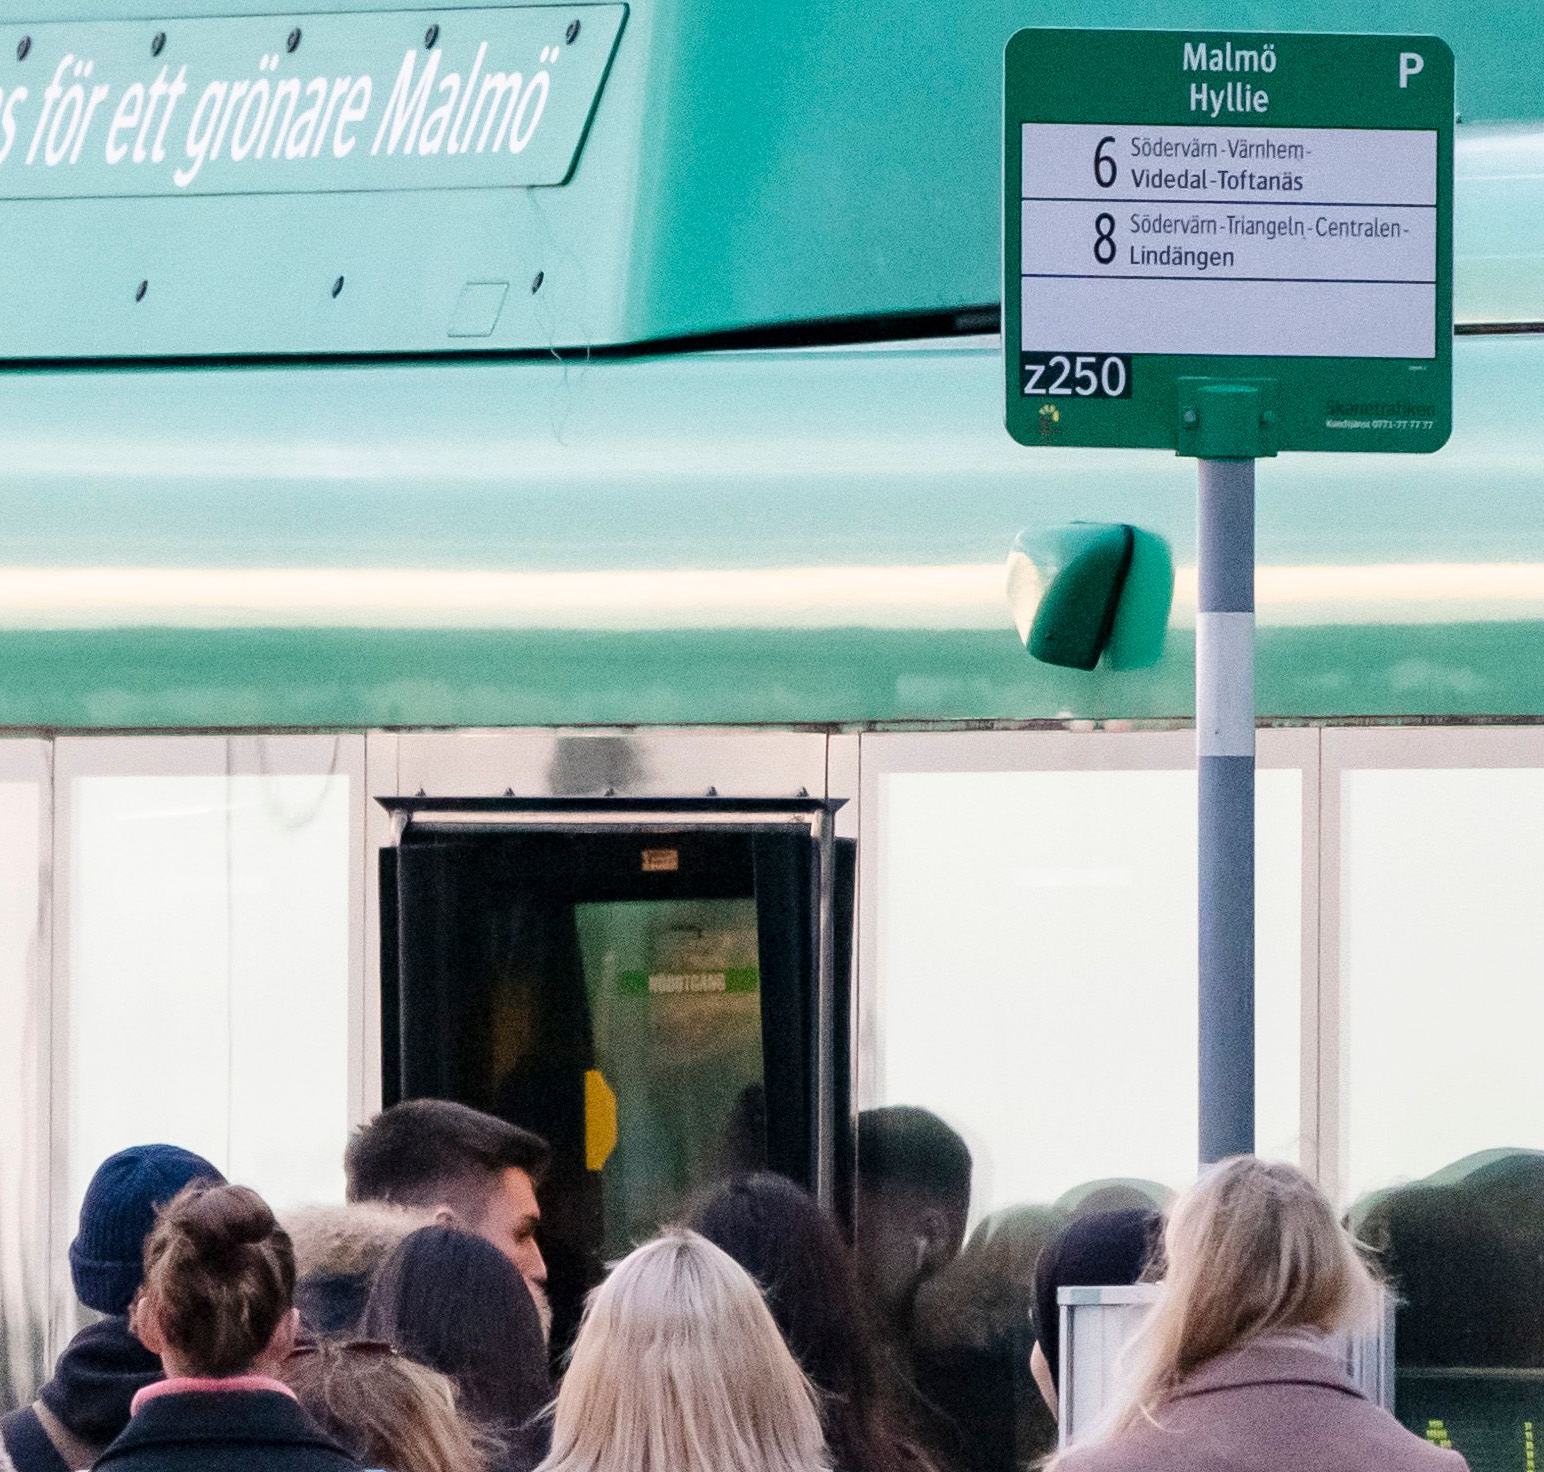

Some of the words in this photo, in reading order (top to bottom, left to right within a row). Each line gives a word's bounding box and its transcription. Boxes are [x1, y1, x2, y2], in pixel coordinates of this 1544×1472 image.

[1182, 42, 1277, 73] Malmö
[1398, 52, 1425, 89] P
[24, 53, 110, 167] för
[105, 64, 187, 164] ett
[172, 53, 373, 188] grönare
[370, 41, 560, 157] Malmö
[1189, 82, 1269, 118] Hyllie
[1093, 135, 1118, 189] 6
[1093, 212, 1117, 265] 8
[1129, 245, 1235, 271] Lindängen
[1023, 356, 1127, 397] z250
